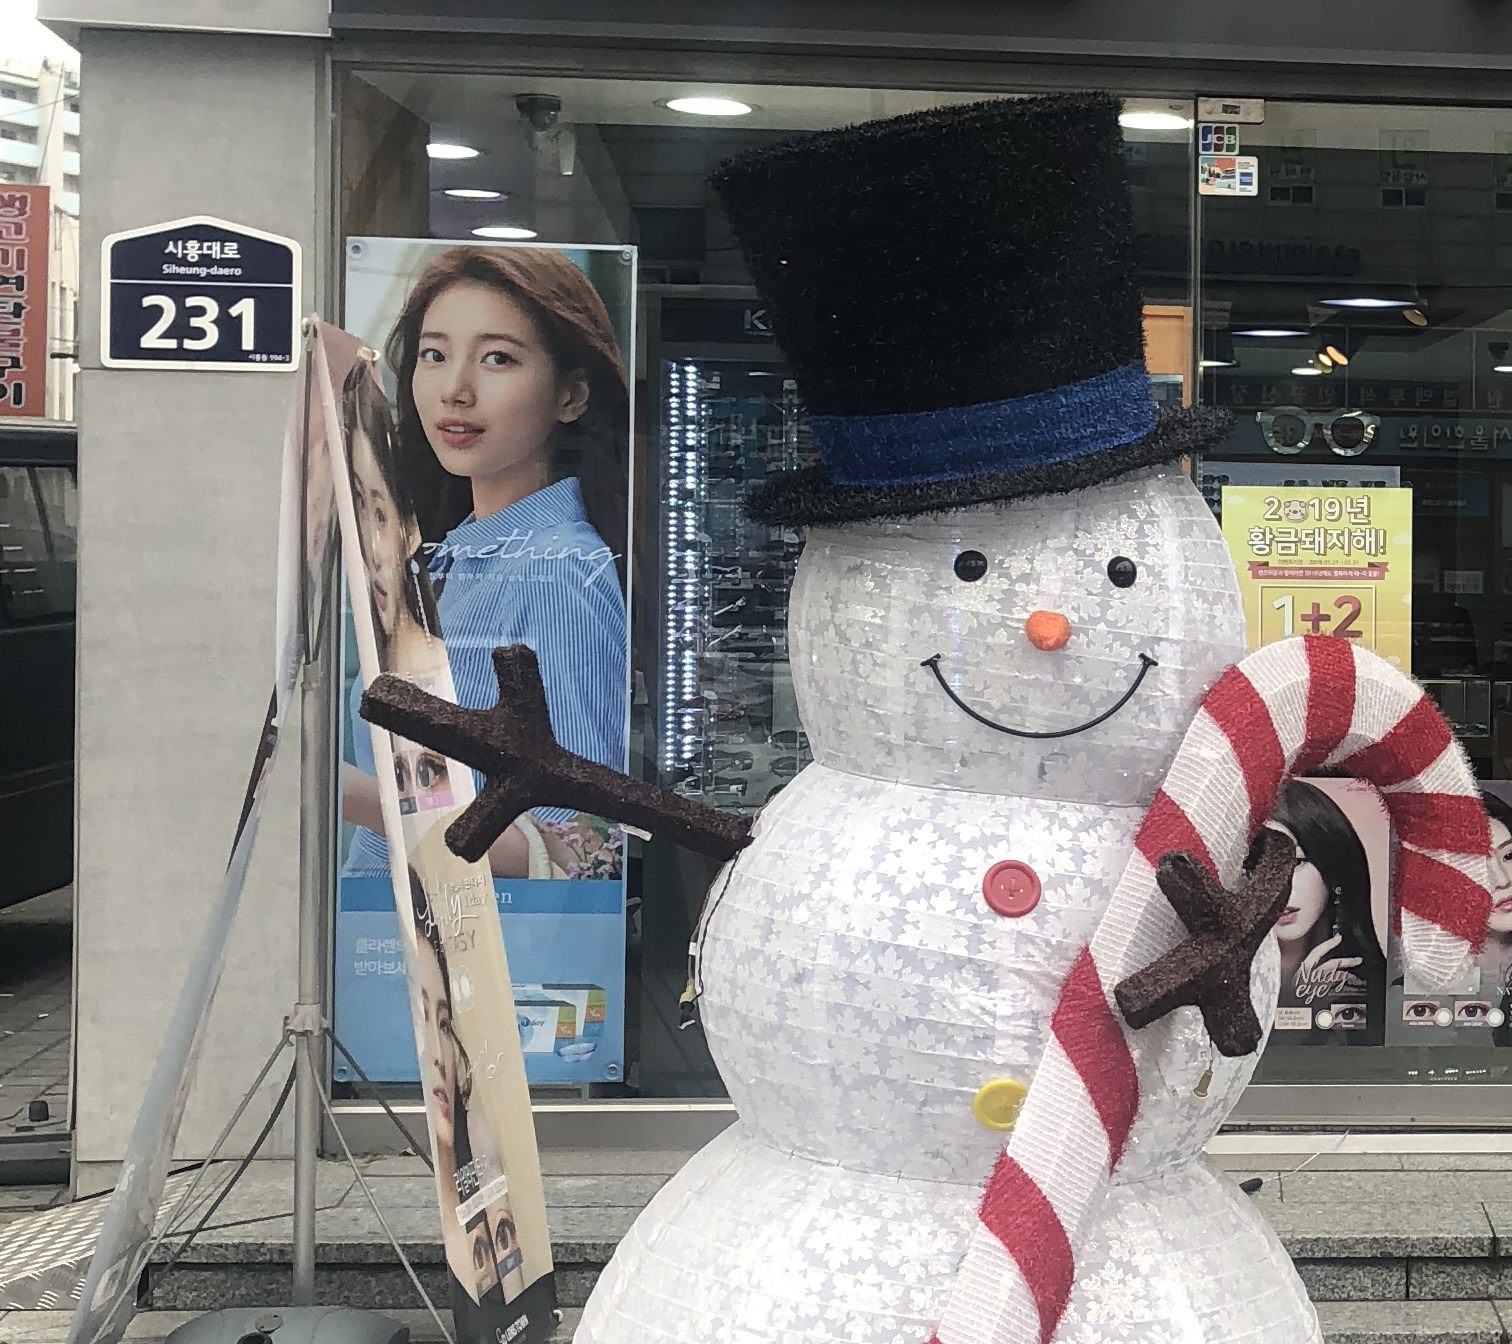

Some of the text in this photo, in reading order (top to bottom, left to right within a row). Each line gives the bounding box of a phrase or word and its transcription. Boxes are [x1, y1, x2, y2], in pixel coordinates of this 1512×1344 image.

[164, 240, 242, 263] 시흥대로
[162, 264, 243, 277] Siheung-daero
[139, 294, 256, 351] 231
[1247, 525, 1388, 557] 황금돼지해!
[1271, 594, 1363, 640] 1+2
[1295, 984, 1332, 1005] eye
